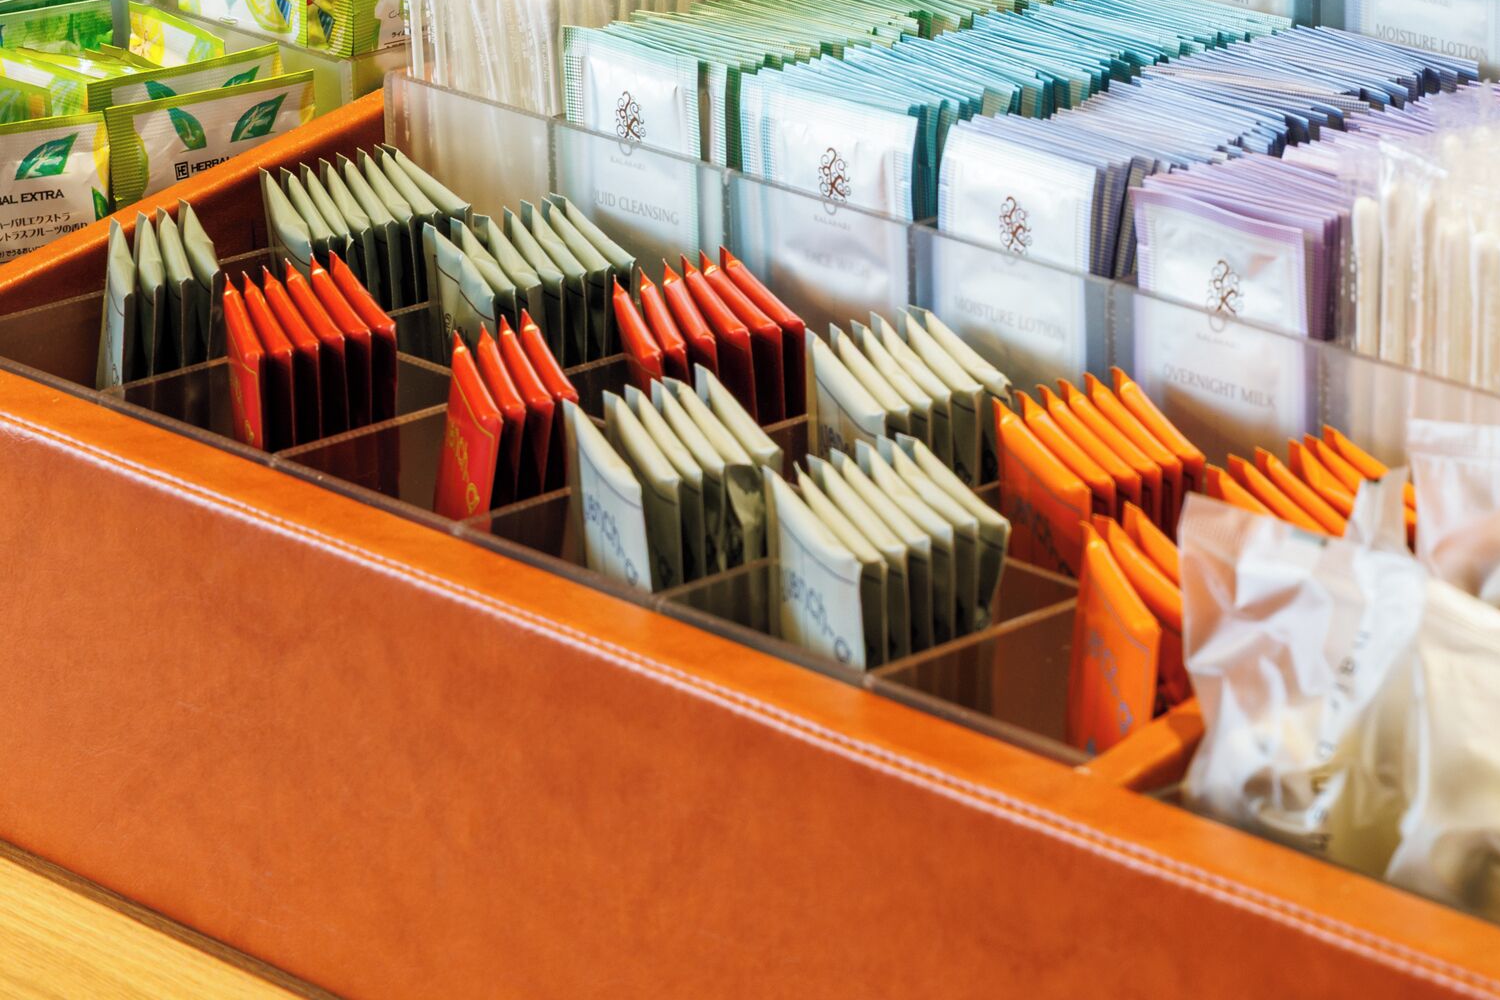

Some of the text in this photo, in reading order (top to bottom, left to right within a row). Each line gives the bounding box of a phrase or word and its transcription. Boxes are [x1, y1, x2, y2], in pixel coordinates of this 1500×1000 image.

[1375, 23, 1489, 61] MOISTURE LOTION
[21, 189, 65, 203] EXTRA
[618, 196, 679, 226] CLEANSING
[953, 294, 1066, 342] MOISTURE LOTION
[1162, 363, 1277, 409] OVERNIGHT MILK
